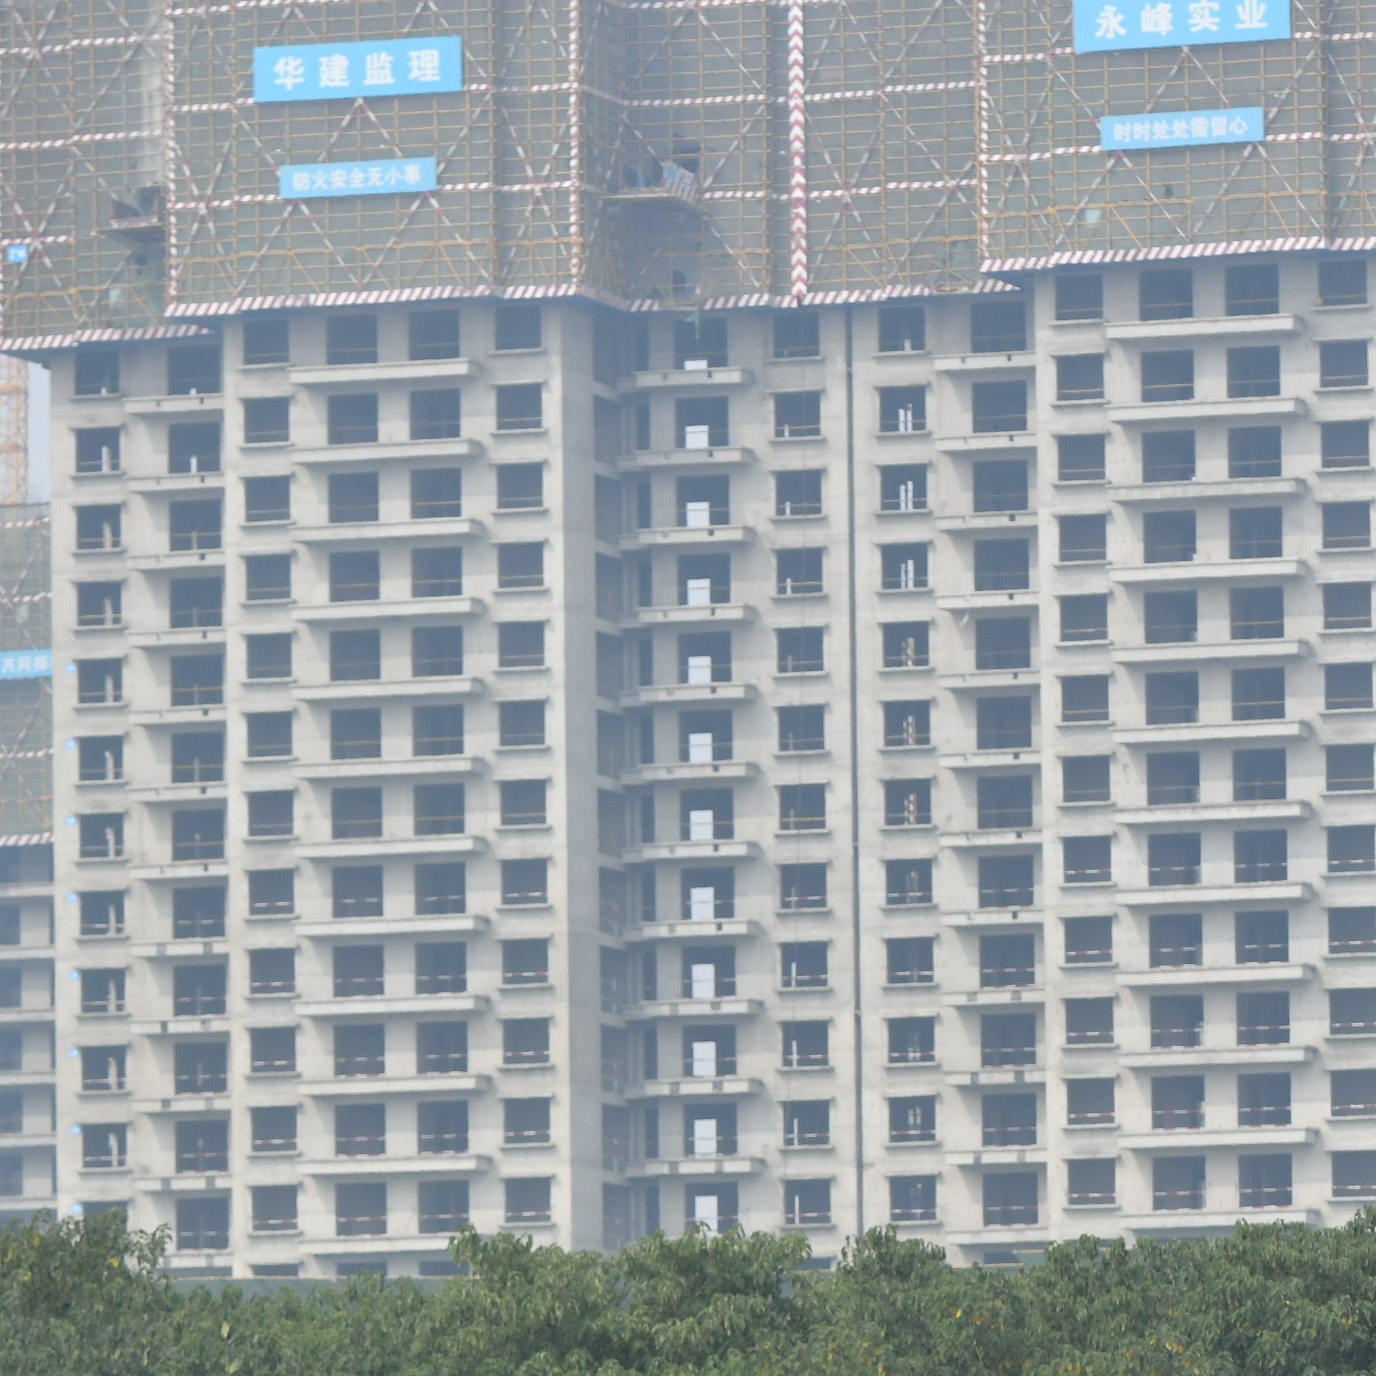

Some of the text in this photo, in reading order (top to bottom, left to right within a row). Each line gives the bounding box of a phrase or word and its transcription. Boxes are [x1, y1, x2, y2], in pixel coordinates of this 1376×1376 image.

[1095, 0, 1268, 39] 永峰实业
[273, 49, 441, 90] 华建监理
[1113, 116, 1249, 142] 时时处处需留心
[292, 164, 422, 191] 防火安全无小事
